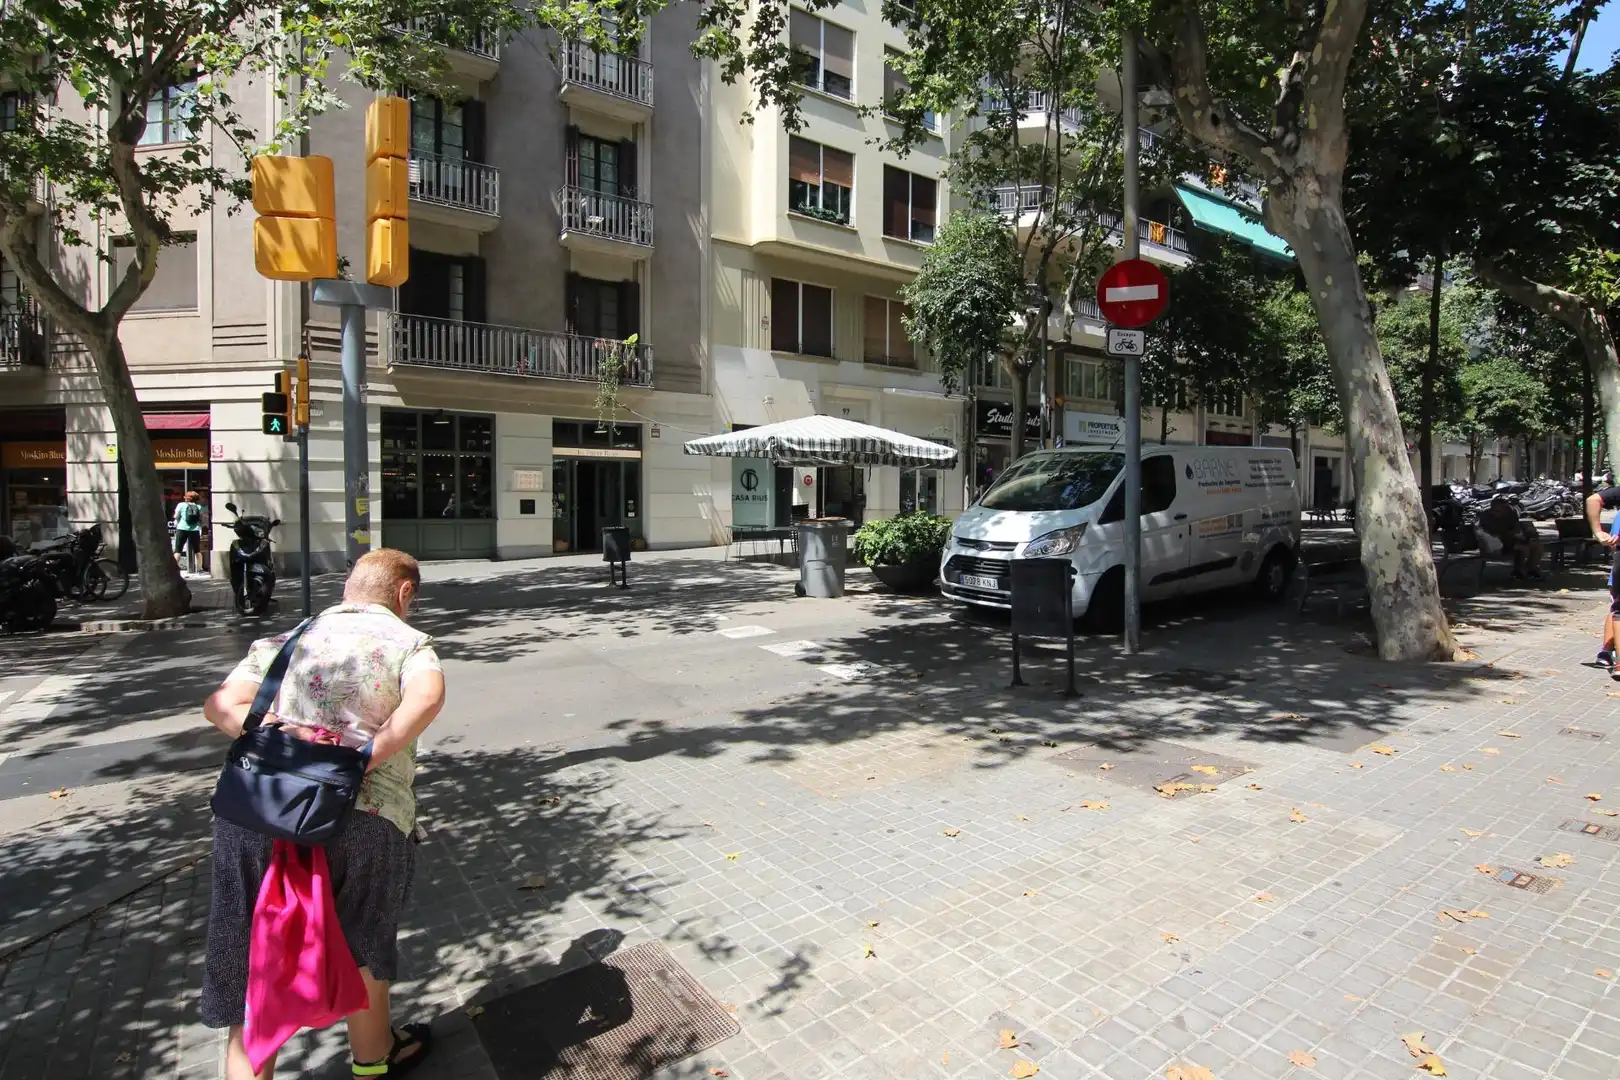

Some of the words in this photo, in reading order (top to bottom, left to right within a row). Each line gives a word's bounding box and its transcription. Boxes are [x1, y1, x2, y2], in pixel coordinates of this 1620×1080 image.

[987, 408, 1014, 424] Studi
[1087, 421, 1118, 431] PROPERTIES
[20, 450, 48, 460] Moskito
[49, 450, 64, 459] Blue
[156, 448, 186, 458] Moskito
[187, 448, 204, 458] Blue
[752, 494, 768, 502] RIUS
